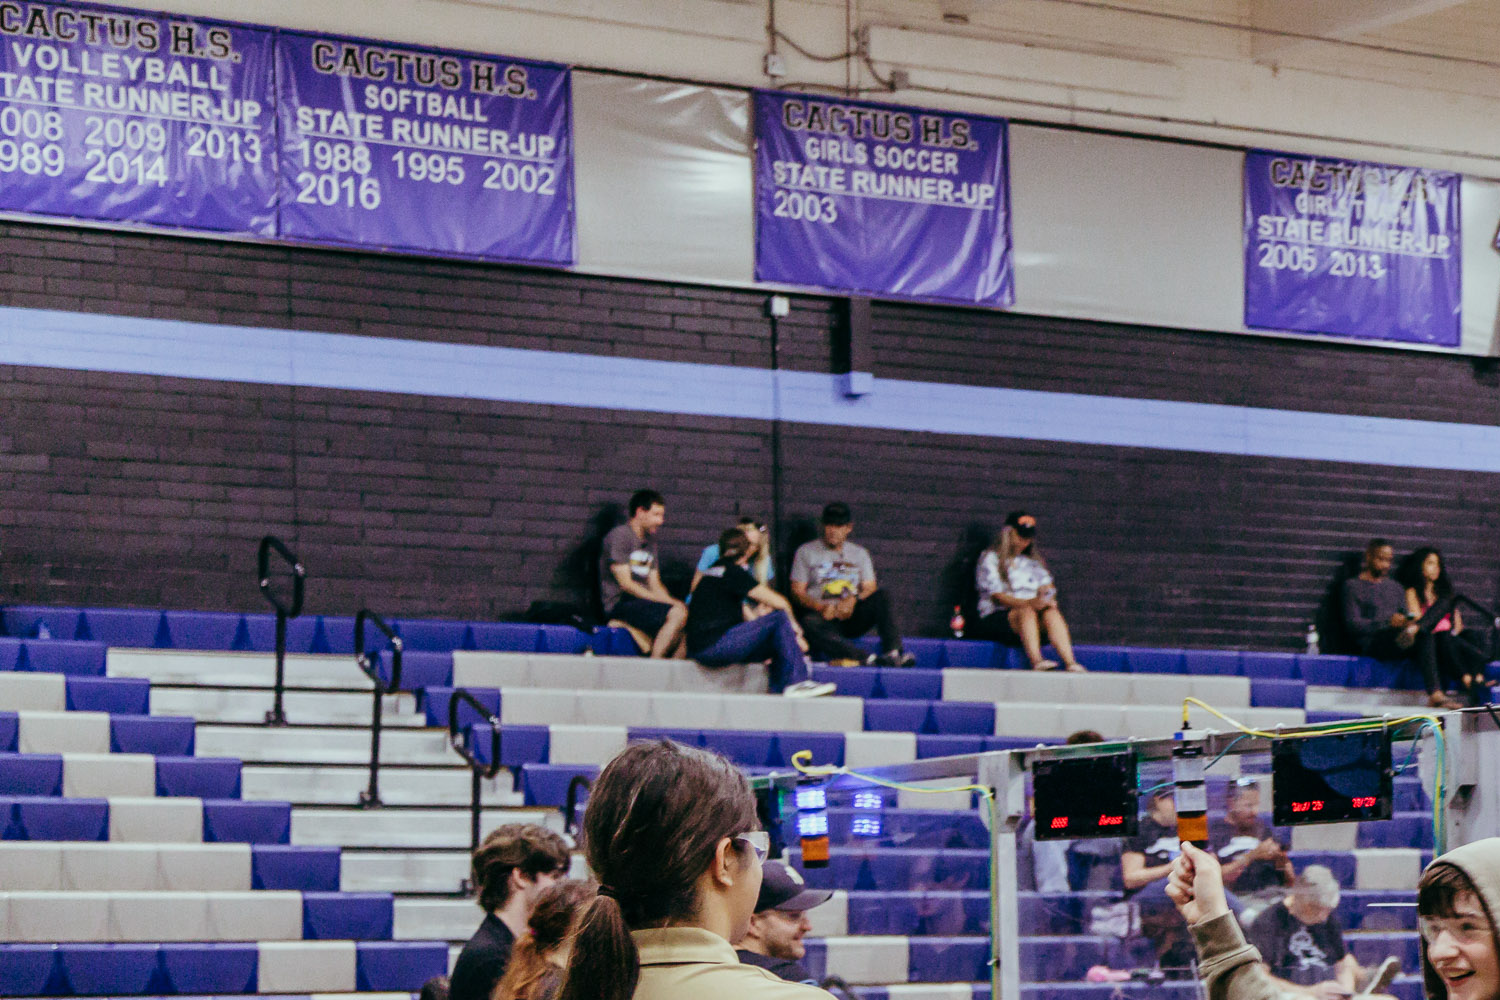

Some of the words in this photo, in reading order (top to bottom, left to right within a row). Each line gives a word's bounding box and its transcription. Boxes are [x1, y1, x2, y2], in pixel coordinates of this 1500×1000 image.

[0, 1, 160, 52] CACTUS
[169, 22, 241, 63] H.S.
[12, 41, 228, 91] VOLLEYBALL
[312, 40, 461, 90] CACTUS
[470, 60, 537, 100] H.S.
[0, 72, 74, 104] TATE
[83, 82, 261, 125] RUNNER-UP
[364, 84, 488, 122] SOFTBALL
[0, 107, 64, 142] 008
[85, 116, 165, 153] 2009
[188, 127, 262, 163] 2013
[297, 106, 383, 140] STATE
[392, 116, 556, 158] RUNNER-UP
[783, 99, 912, 142] CACTUS
[921, 115, 979, 151] H.S.
[0, 139, 65, 177] 989
[85, 148, 168, 188] 2014
[300, 140, 371, 175] 1988
[392, 150, 465, 185] 1995
[483, 161, 555, 195] 2002
[805, 136, 868, 165] GIRLS
[874, 145, 959, 175] SOCCER
[1270, 158, 1381, 198] CACT
[296, 171, 381, 210] 2016
[773, 160, 845, 190] STATE
[853, 171, 995, 206] RUNNER-UP
[773, 190, 838, 223] 2003
[1258, 214, 1325, 242] STATE
[1329, 222, 1450, 253] RUNNER-UP
[1259, 242, 1318, 272] 2005
[1328, 250, 1387, 279] 2013
